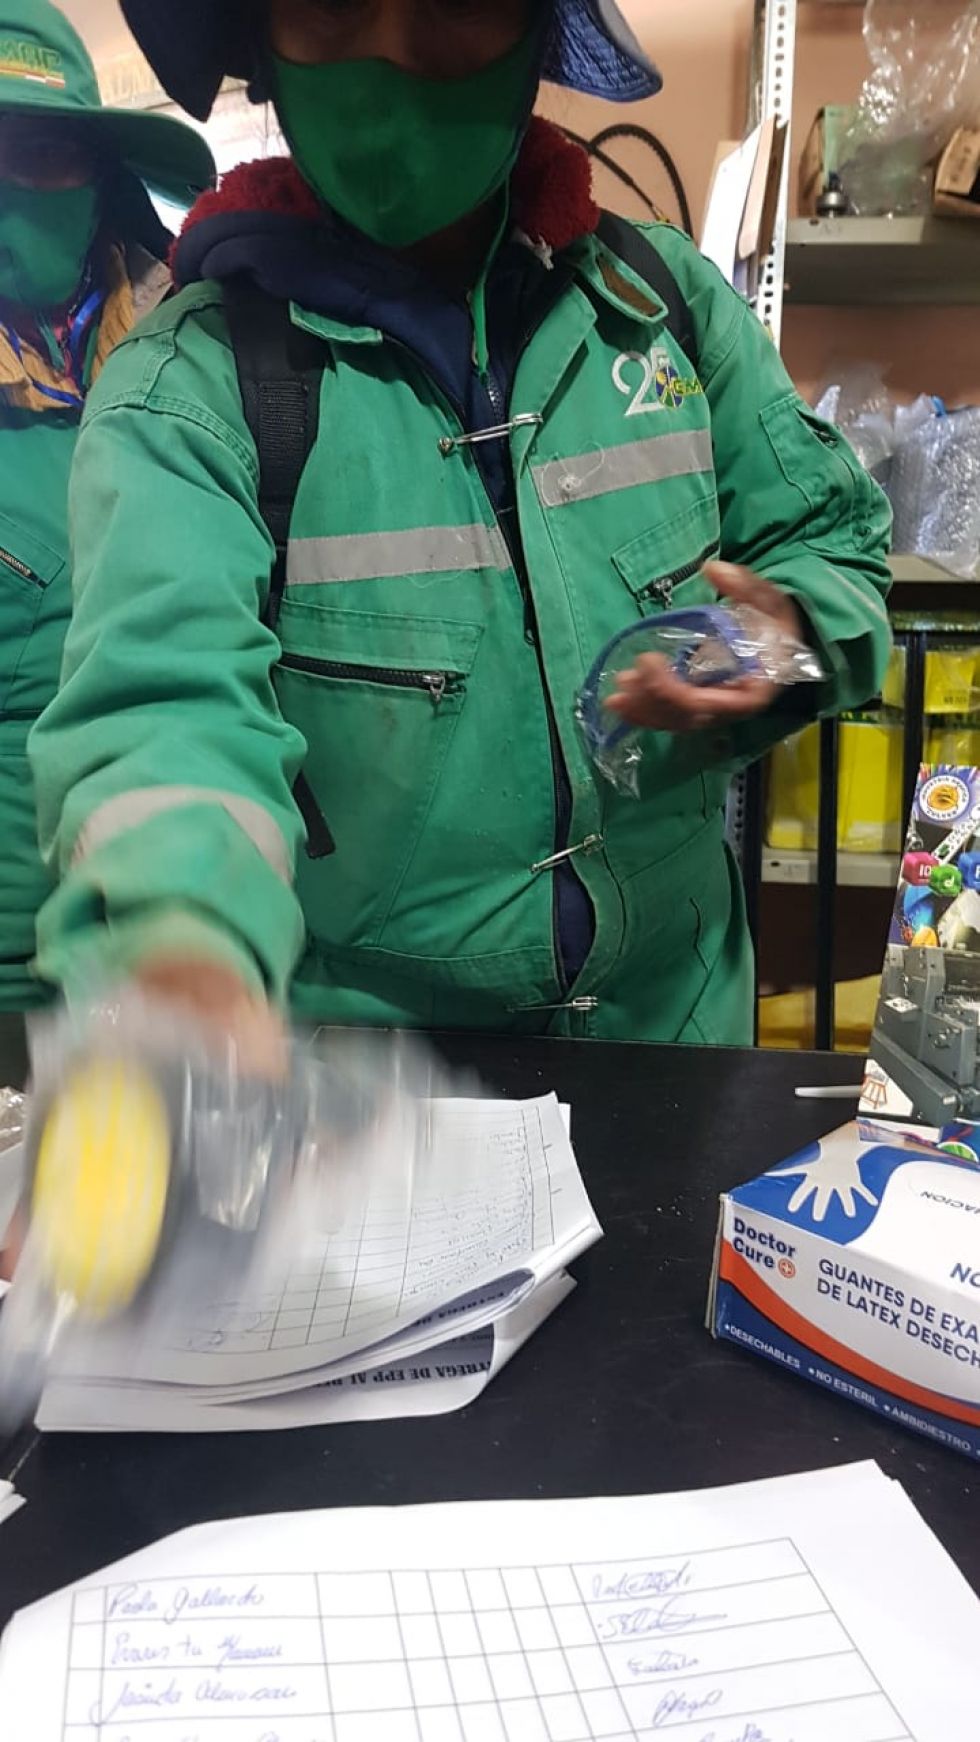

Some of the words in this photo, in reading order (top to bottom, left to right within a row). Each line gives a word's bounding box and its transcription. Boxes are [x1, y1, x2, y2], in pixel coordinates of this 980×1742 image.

[733, 1236, 775, 1268] Cure
[734, 1217, 796, 1257] Doctor
[817, 1278, 842, 1301] DE
[846, 1290, 902, 1329] LATEX
[818, 1258, 905, 1308] GUANTES
[910, 1297, 936, 1323] DE
[373, 1369, 405, 1383] EPP
[409, 1366, 431, 1379] DE
[816, 1369, 833, 1384] NO
[833, 1377, 878, 1407] ESTERIL
